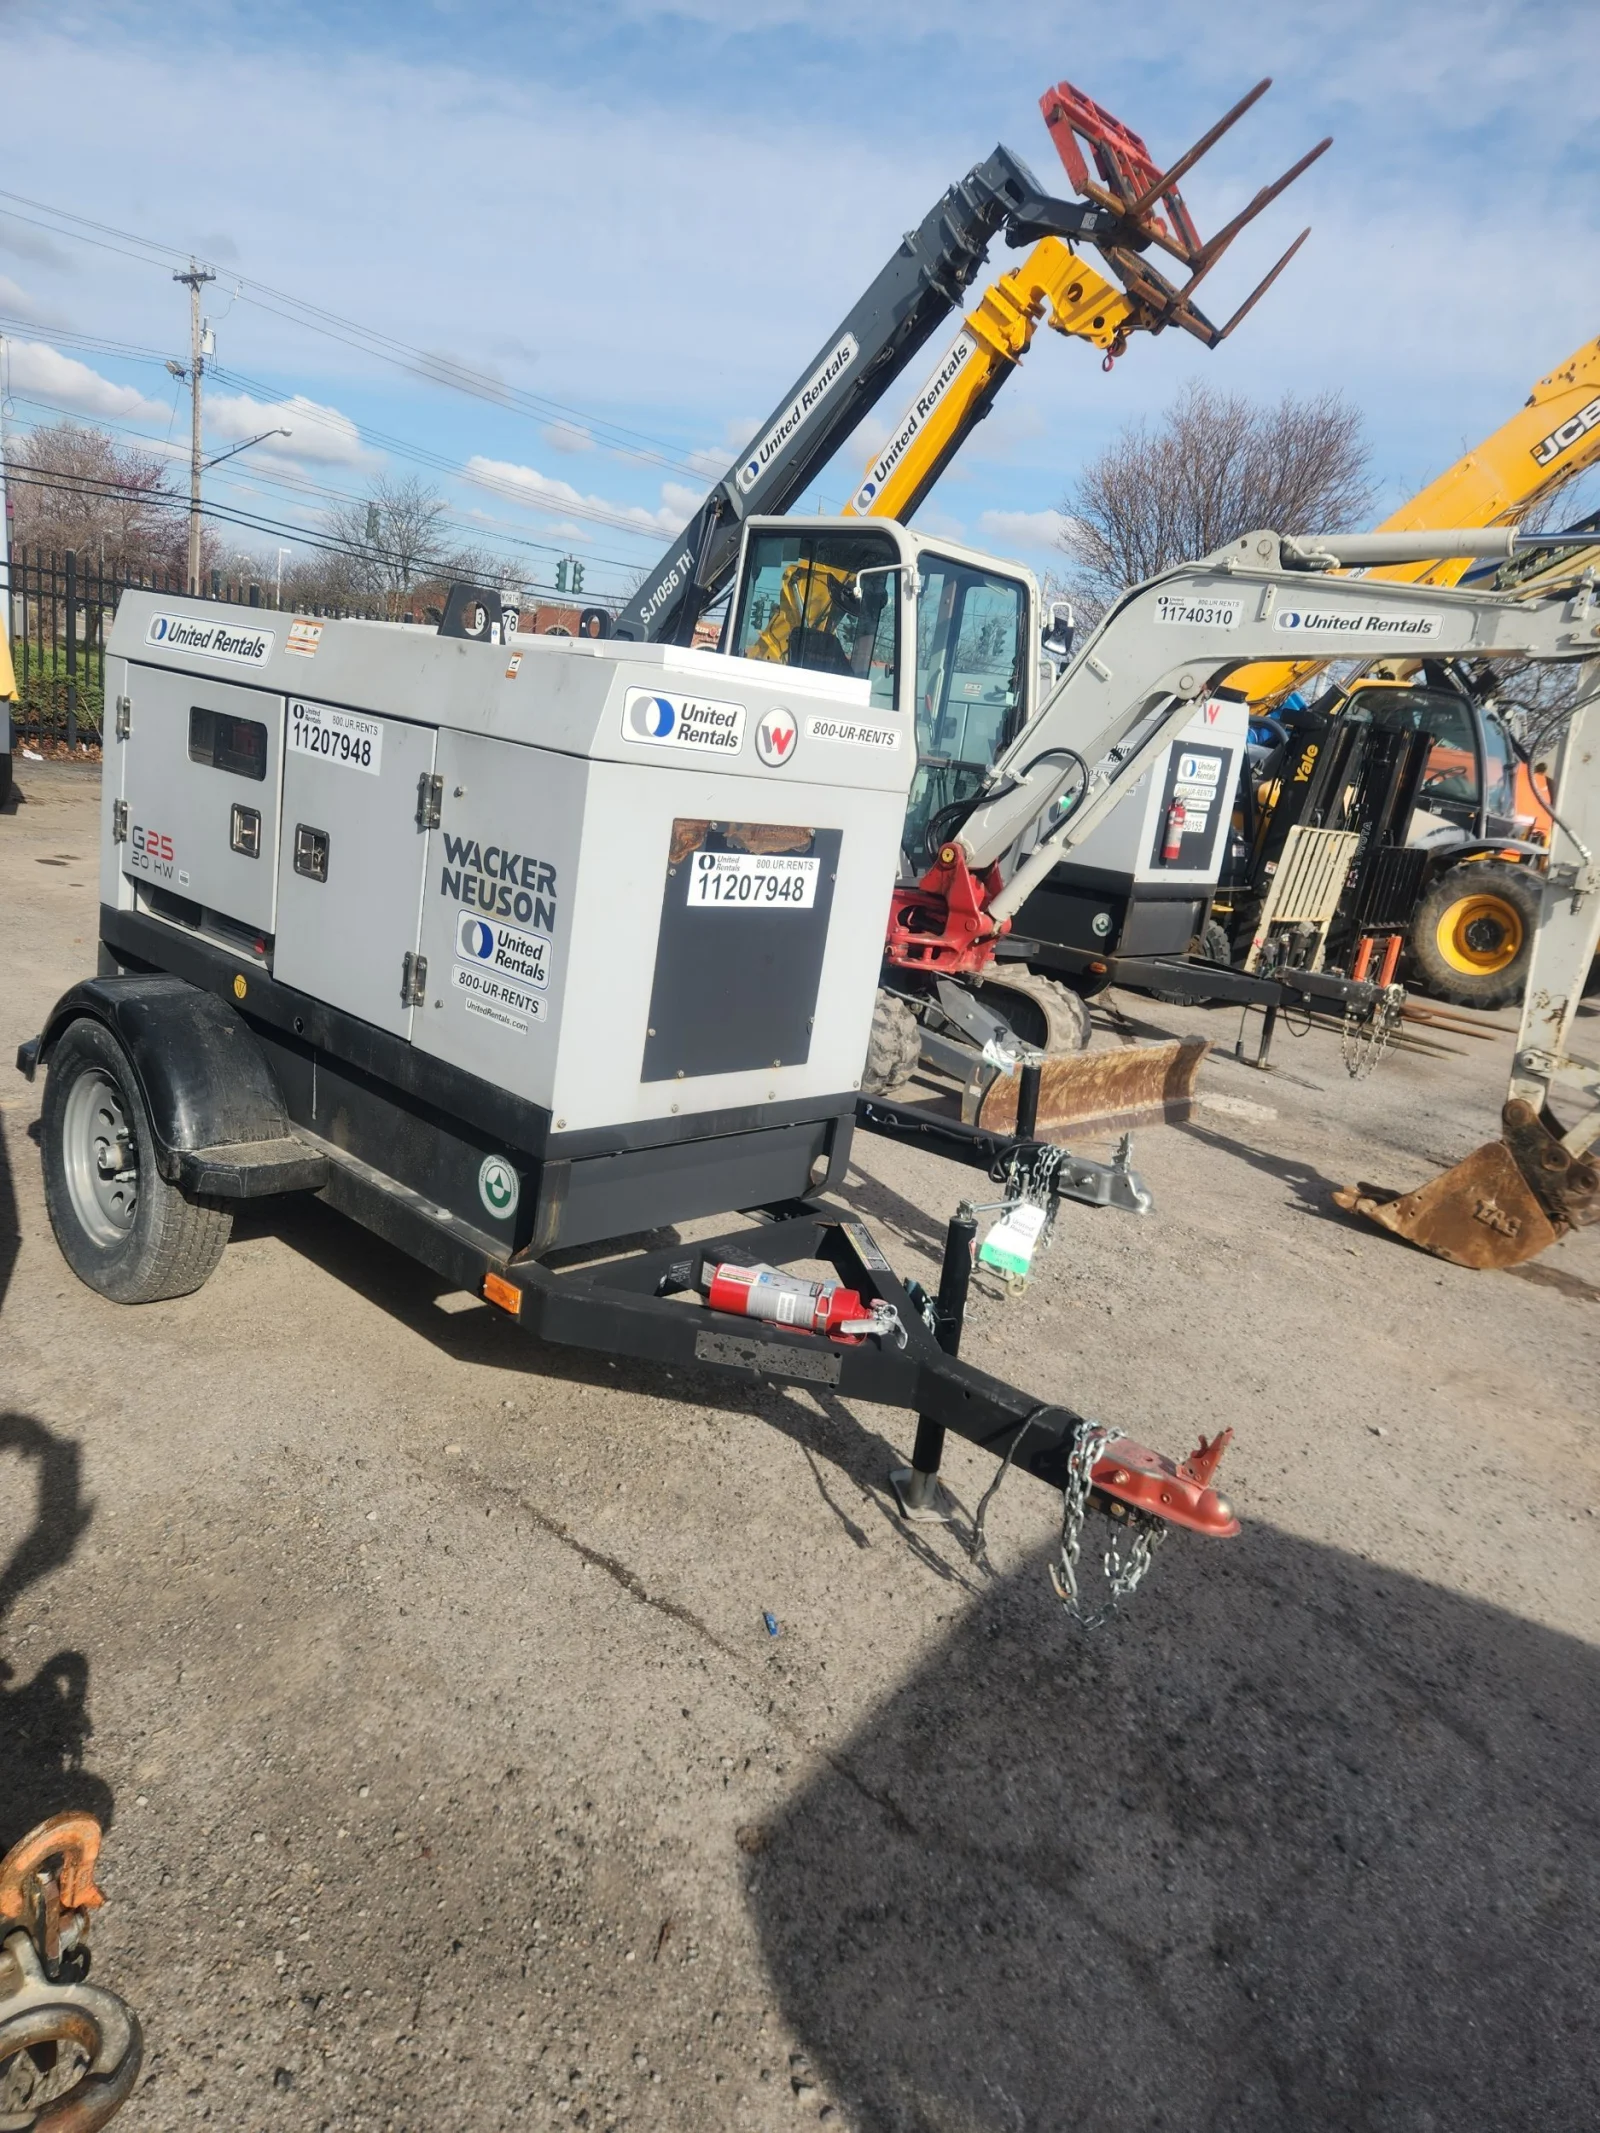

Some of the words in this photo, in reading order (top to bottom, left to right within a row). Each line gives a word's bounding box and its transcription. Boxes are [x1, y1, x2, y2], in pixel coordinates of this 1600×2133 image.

[759, 405, 801, 464] United
[801, 346, 851, 411] Rentals
[874, 416, 918, 483] United
[916, 344, 968, 419] Rentals
[640, 569, 679, 624] SJ1056
[676, 548, 695, 575] TH
[503, 614, 517, 632] 78
[1161, 606, 1233, 625] 11740310
[1304, 614, 1363, 631] United
[1365, 616, 1434, 634] Rentals
[168, 621, 214, 649] United
[212, 629, 266, 658] Rentals
[305, 706, 321, 717] United
[305, 714, 321, 724] Rentals
[680, 702, 738, 727] United
[294, 721, 371, 767] 11207948
[677, 723, 739, 748] Rentals
[813, 721, 895, 746] 800-UR-RENTS
[1293, 744, 1319, 782] Yale
[132, 825, 174, 862] G25
[717, 855, 740, 864] United
[154, 859, 174, 879] HW
[443, 832, 557, 898] WACKER
[716, 863, 741, 872] Rentals
[440, 866, 556, 933] NEUSON
[699, 872, 805, 902] 11207948
[497, 929, 544, 961] United
[495, 948, 545, 981] Rentals
[458, 971, 540, 1014] 800-UR-RENTS
[466, 999, 529, 1032] UnitedRentals.com
